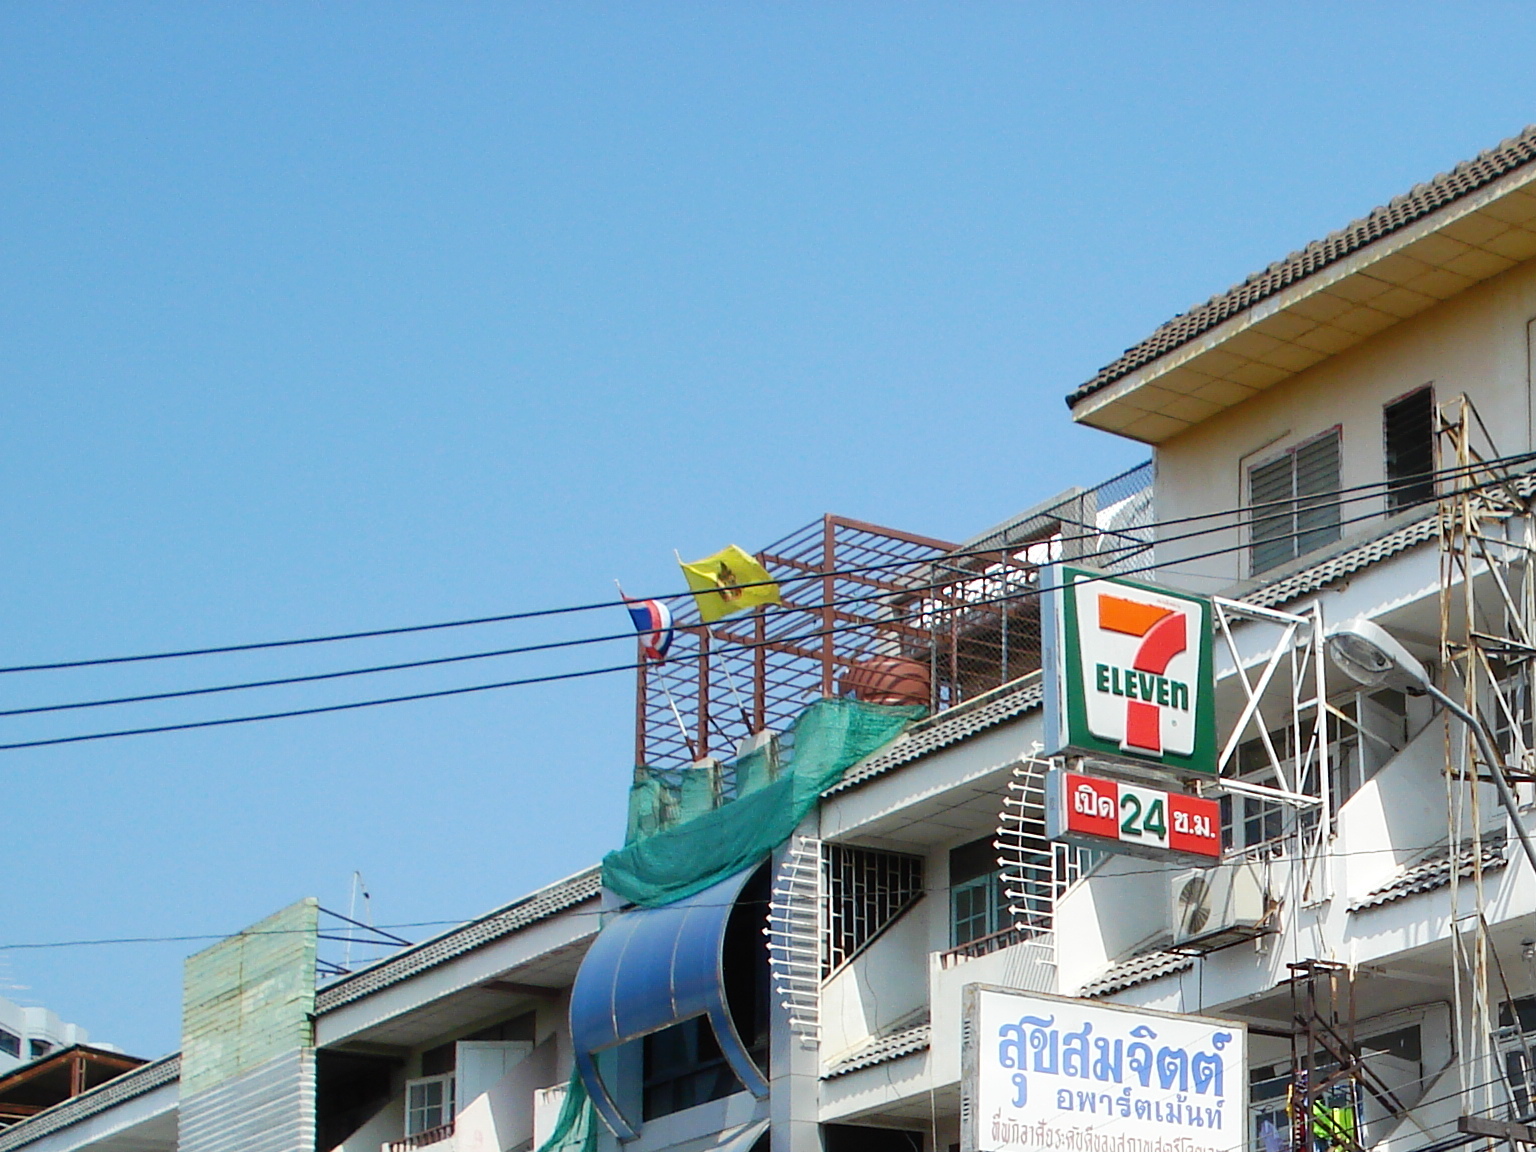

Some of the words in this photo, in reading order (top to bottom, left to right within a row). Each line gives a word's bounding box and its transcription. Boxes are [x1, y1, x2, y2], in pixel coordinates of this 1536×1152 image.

[1098, 593, 1186, 750] 7
[1074, 784, 1115, 819] เปิด
[1120, 793, 1166, 839] 24
[1173, 810, 1216, 838] ช.ม.
